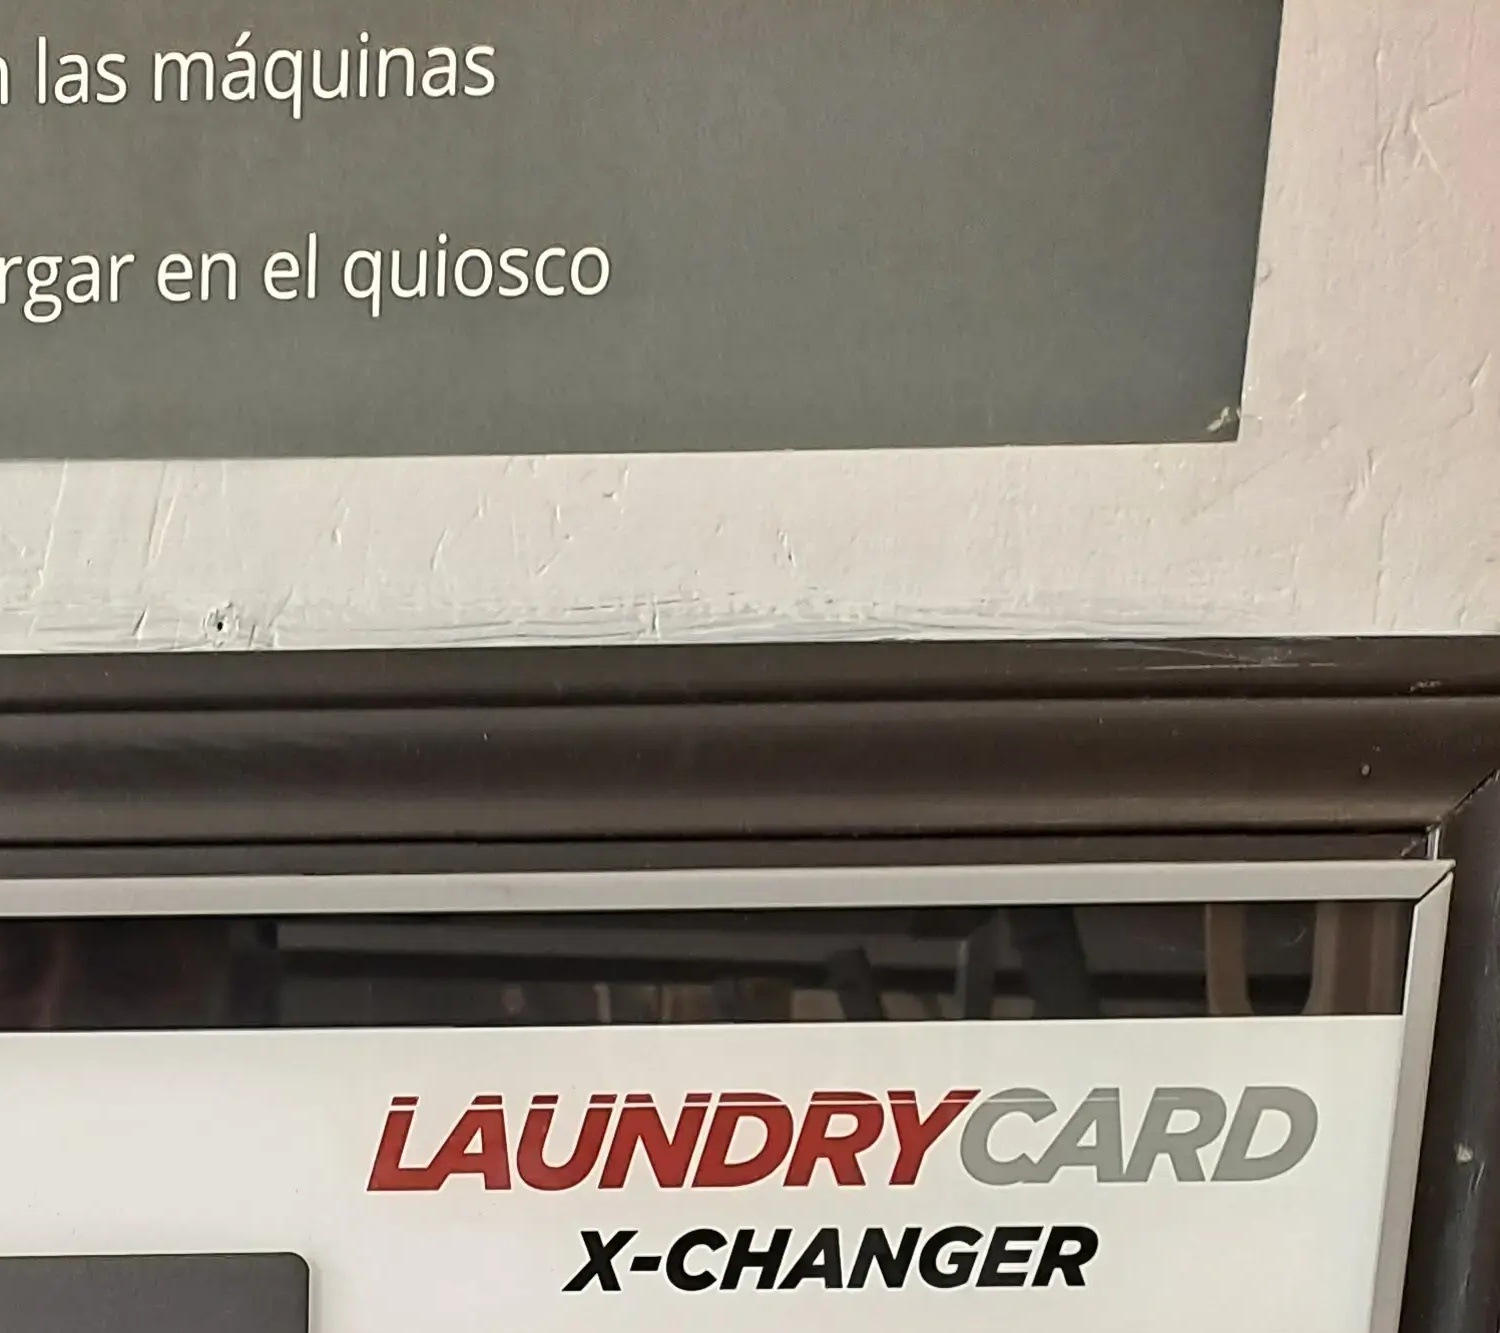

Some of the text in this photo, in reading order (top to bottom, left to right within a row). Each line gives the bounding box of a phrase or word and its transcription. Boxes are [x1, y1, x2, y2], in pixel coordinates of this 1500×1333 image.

[37, 37, 127, 104] las
[153, 32, 495, 119] máquinas
[156, 252, 236, 302] en
[264, 233, 317, 299] el
[343, 233, 611, 317] quiosco
[366, 1086, 1318, 1192] LAUNDRYCARD
[562, 1226, 1098, 1292] X-CHANGER
